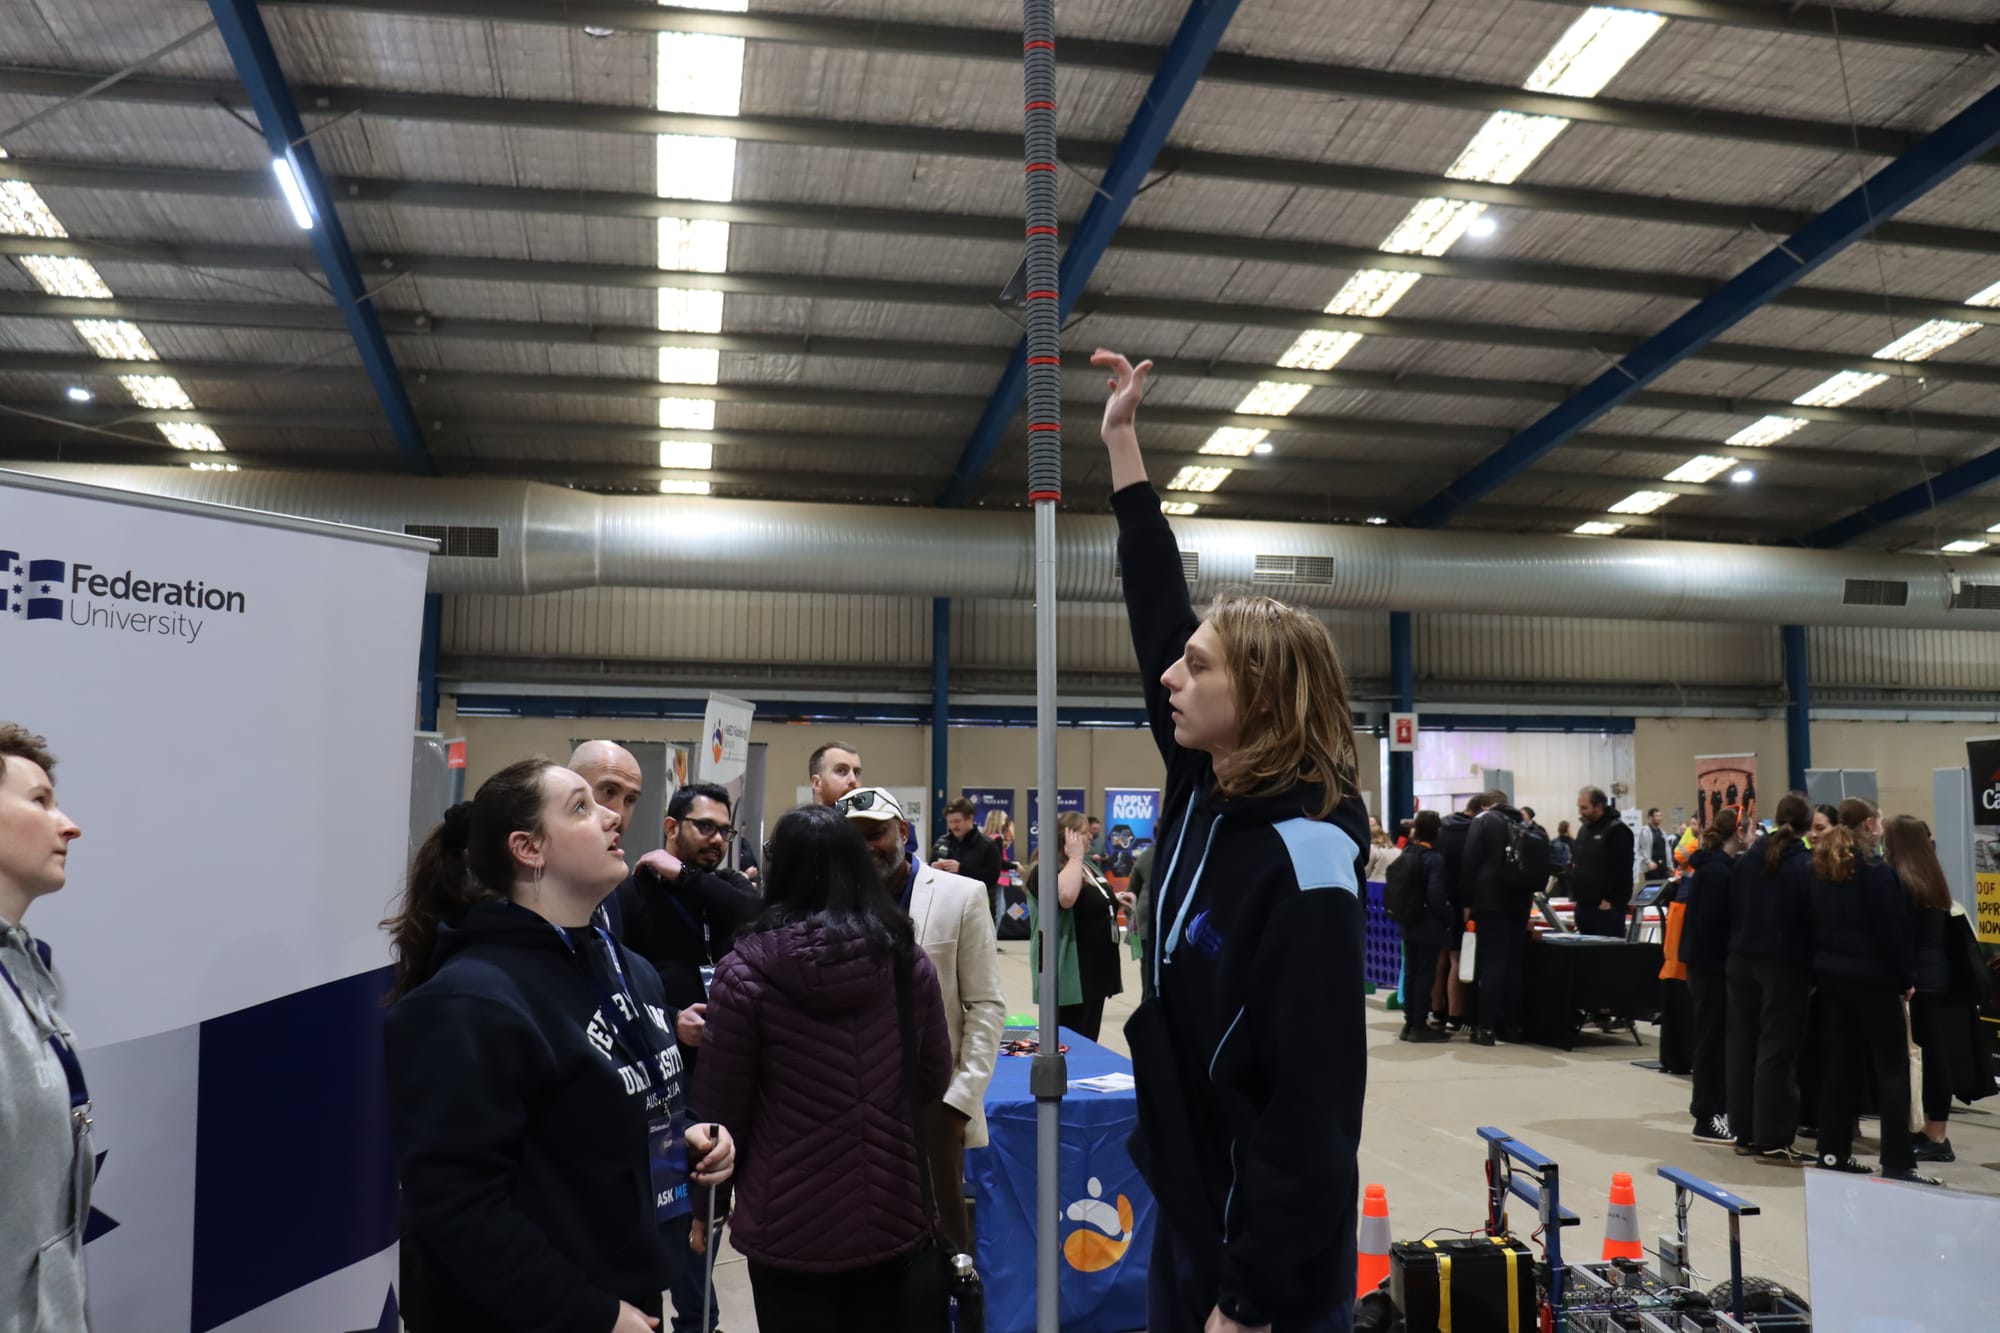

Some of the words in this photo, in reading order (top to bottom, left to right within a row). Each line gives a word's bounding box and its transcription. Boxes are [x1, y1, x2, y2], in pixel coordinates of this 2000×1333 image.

[72, 564, 245, 613] Federation
[70, 599, 203, 643] University
[1113, 794, 1152, 806] APPLY
[1113, 805, 1153, 819] NOW
[657, 1187, 674, 1208] ASK
[674, 1183, 688, 1200] ME
